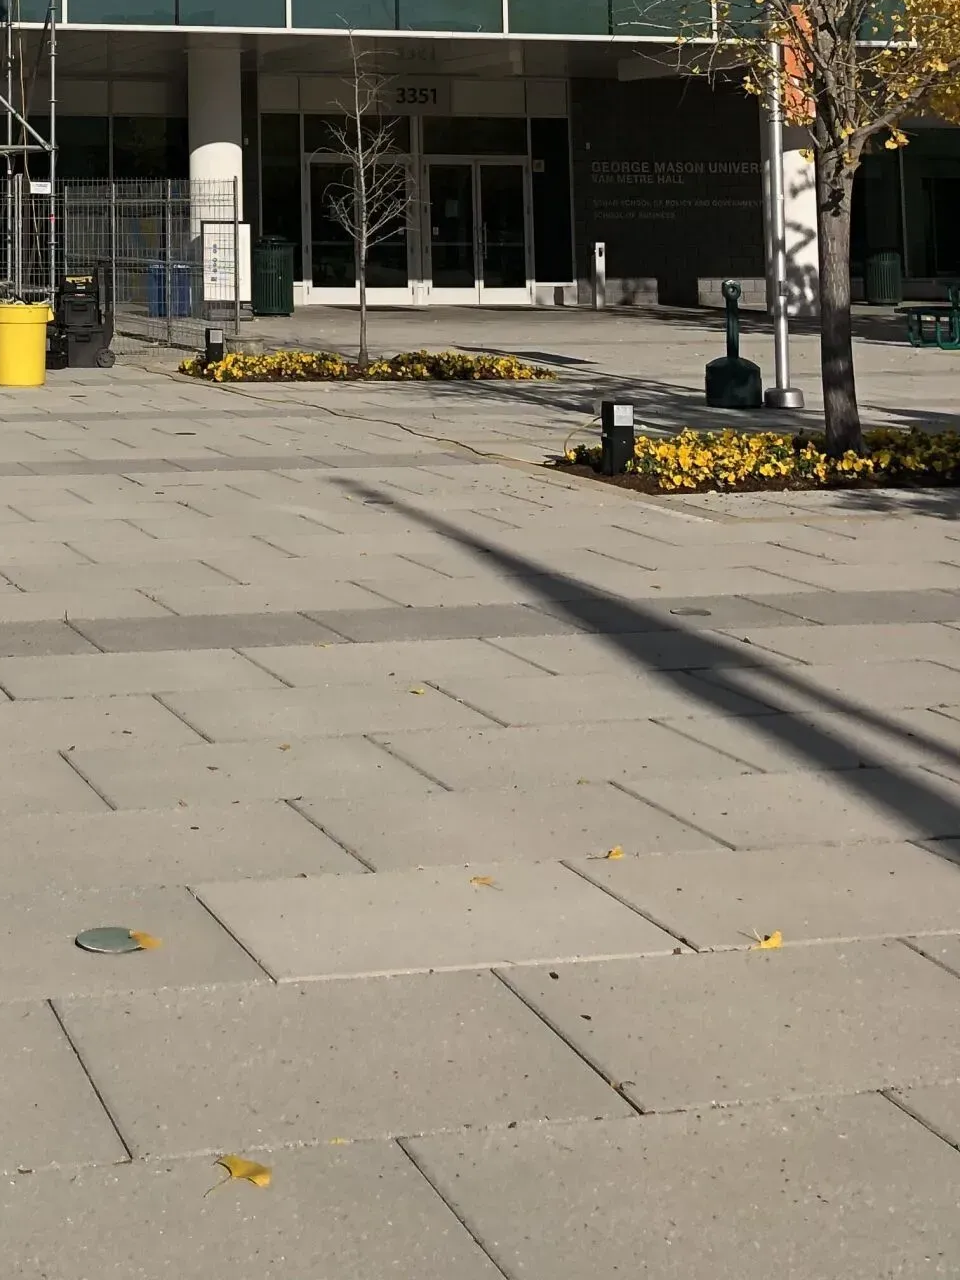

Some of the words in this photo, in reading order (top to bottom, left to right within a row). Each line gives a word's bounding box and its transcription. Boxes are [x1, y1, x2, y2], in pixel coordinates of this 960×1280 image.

[395, 87, 437, 105] 3351
[591, 161, 650, 173] GEORGE
[654, 161, 704, 173] MASON
[616, 174, 654, 184] METRE
[657, 174, 685, 184] HALL
[621, 199, 651, 208] SCHOOL
[665, 199, 692, 208] POLICY
[694, 199, 710, 208] AND
